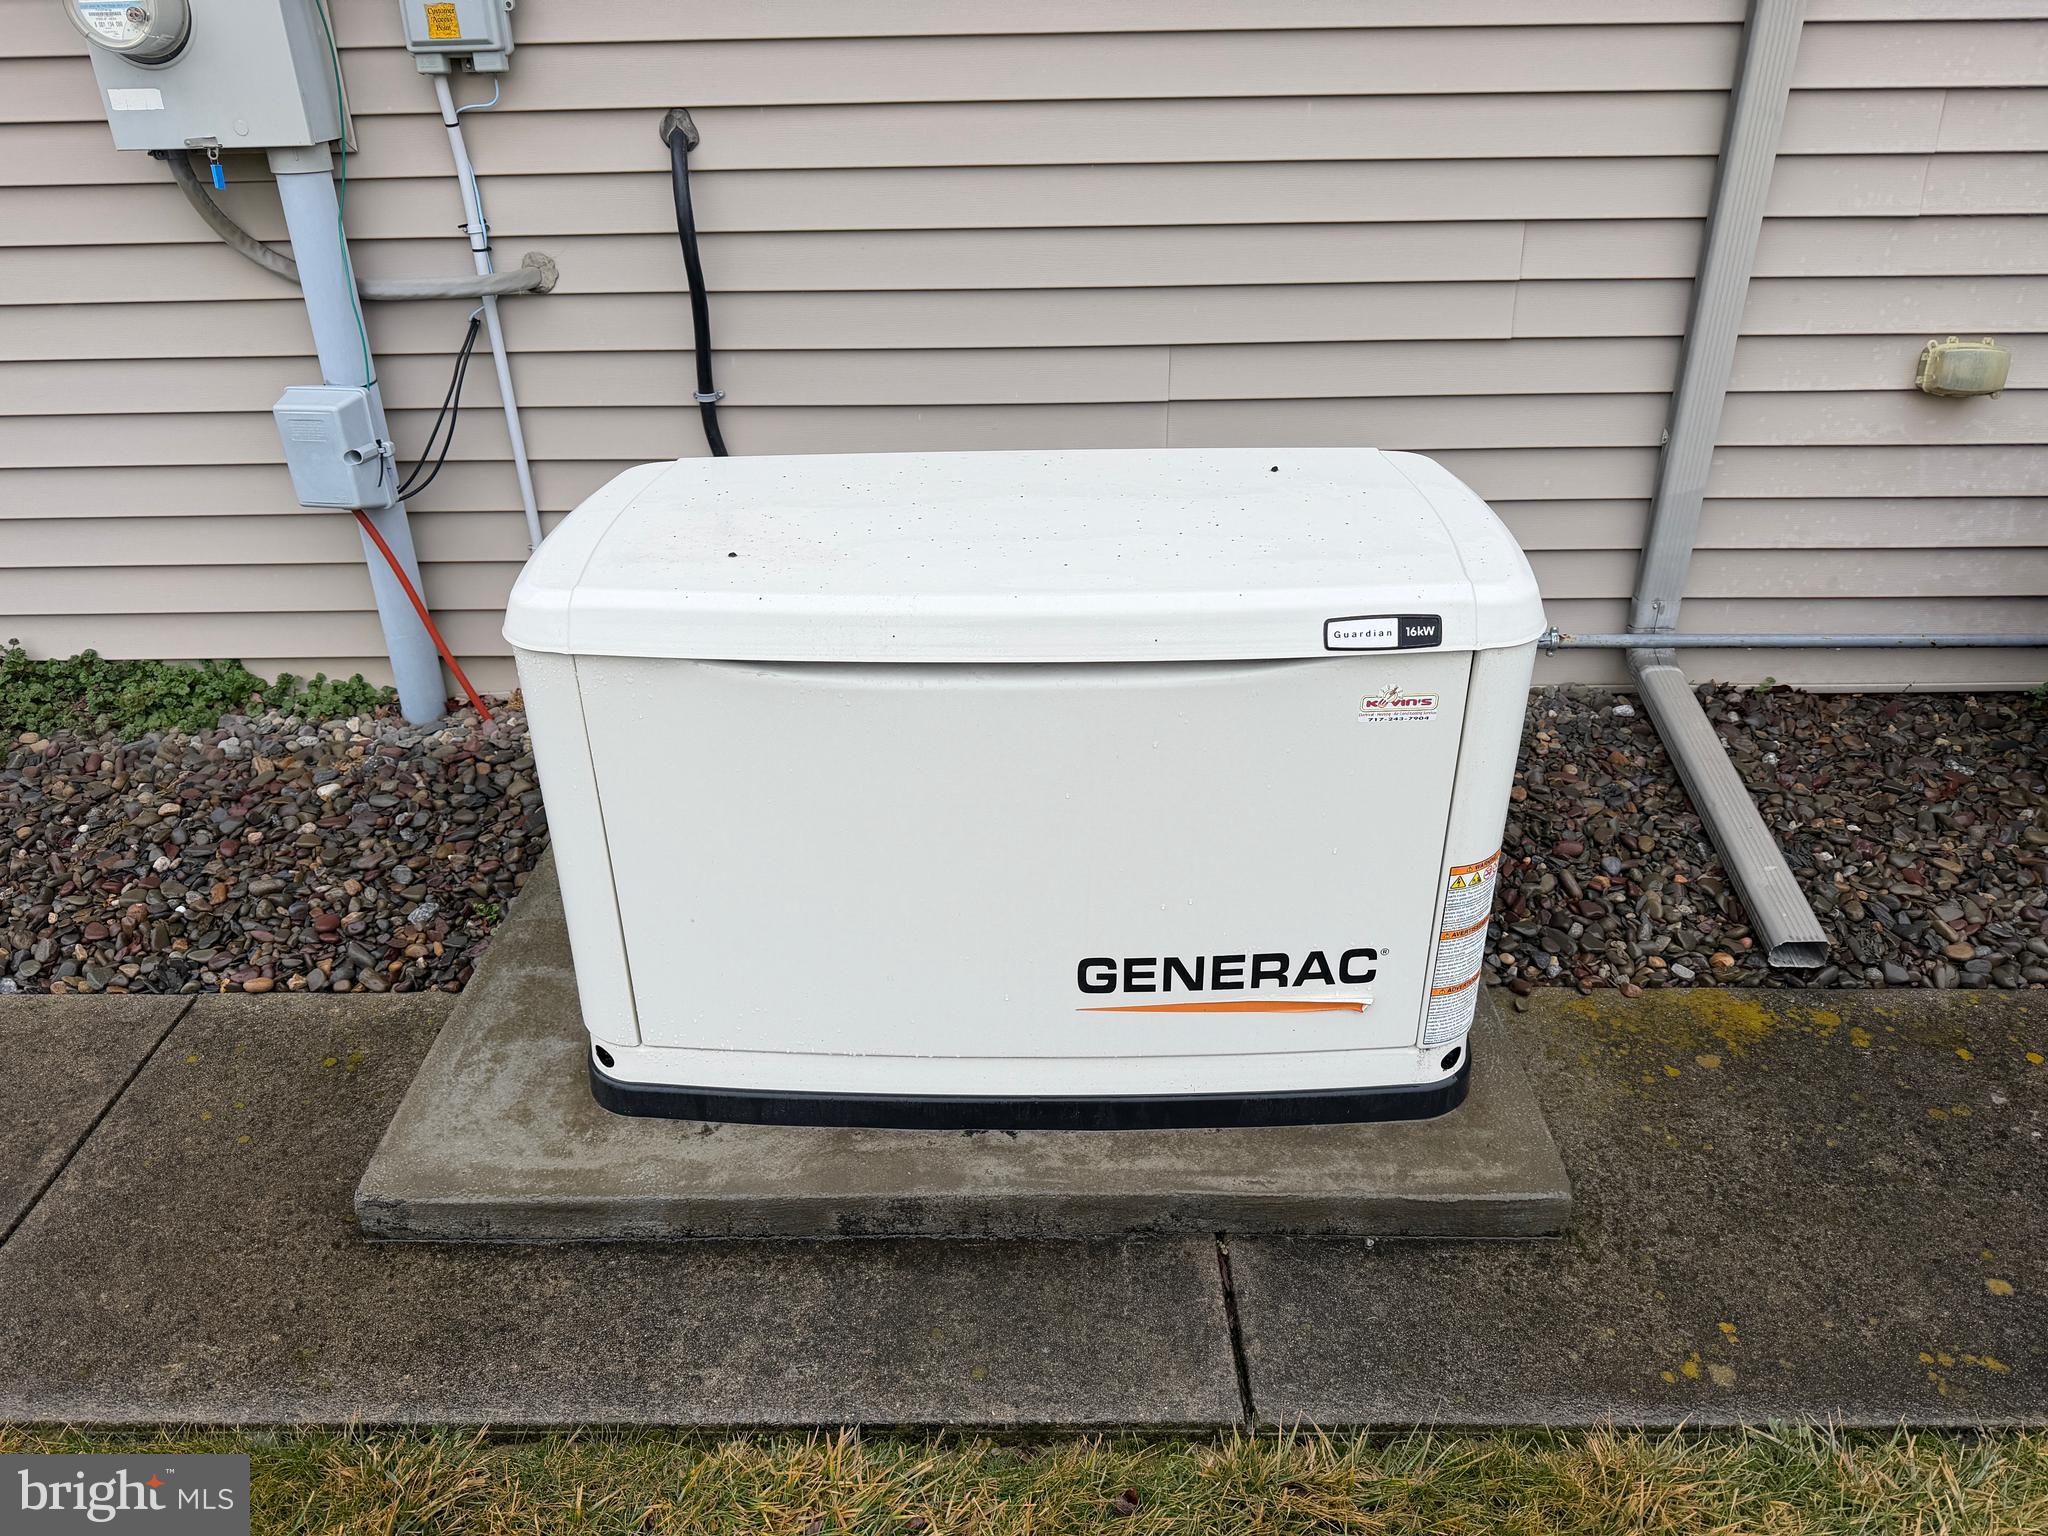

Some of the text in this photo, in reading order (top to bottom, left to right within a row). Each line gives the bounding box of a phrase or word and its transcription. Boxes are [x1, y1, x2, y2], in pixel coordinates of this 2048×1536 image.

[427, 7, 455, 15] Customer
[432, 15, 453, 23] Access
[1333, 625, 1436, 639] Guardian 16kW
[1077, 948, 1378, 994] GENERAC
